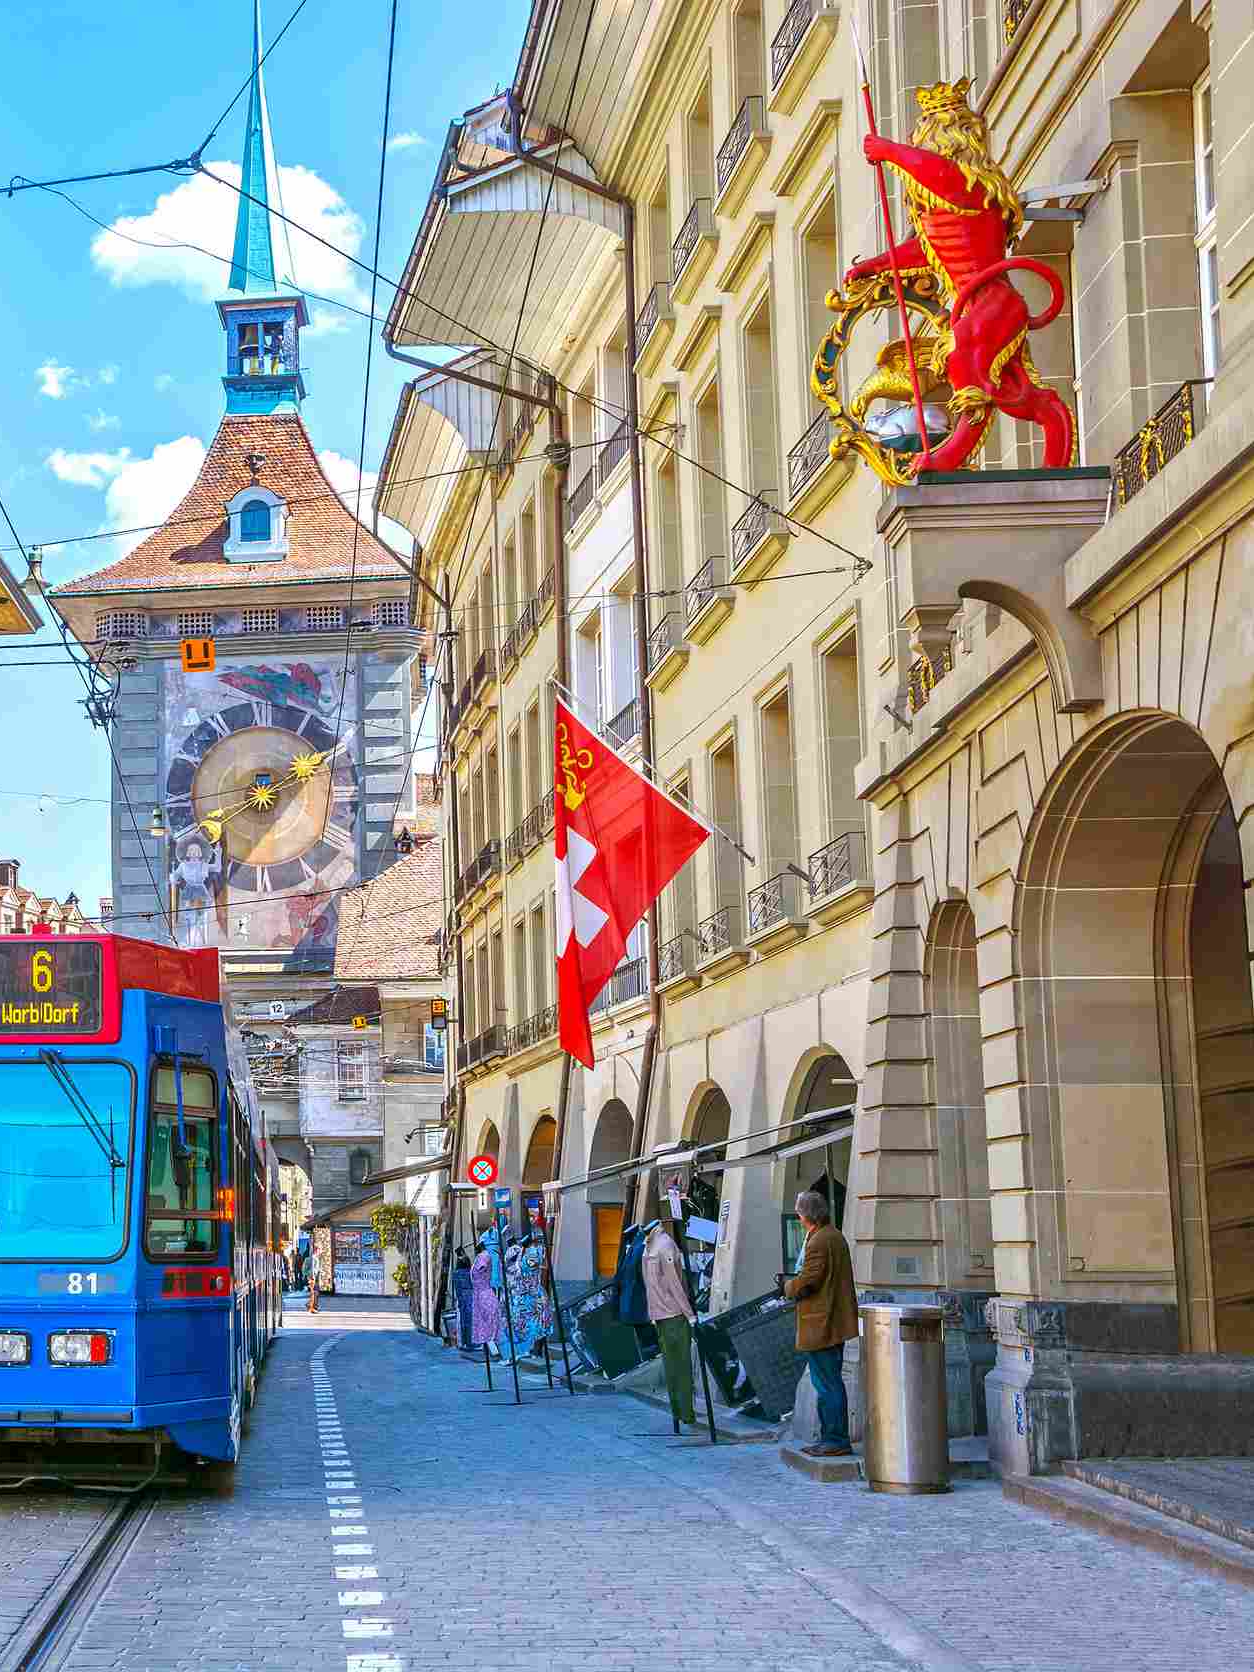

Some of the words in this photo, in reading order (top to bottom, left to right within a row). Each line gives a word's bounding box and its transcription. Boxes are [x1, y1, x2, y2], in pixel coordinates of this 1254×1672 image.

[32, 950, 52, 992] 6
[271, 1003, 283, 1013] 12
[68, 1272, 97, 1295] 81
